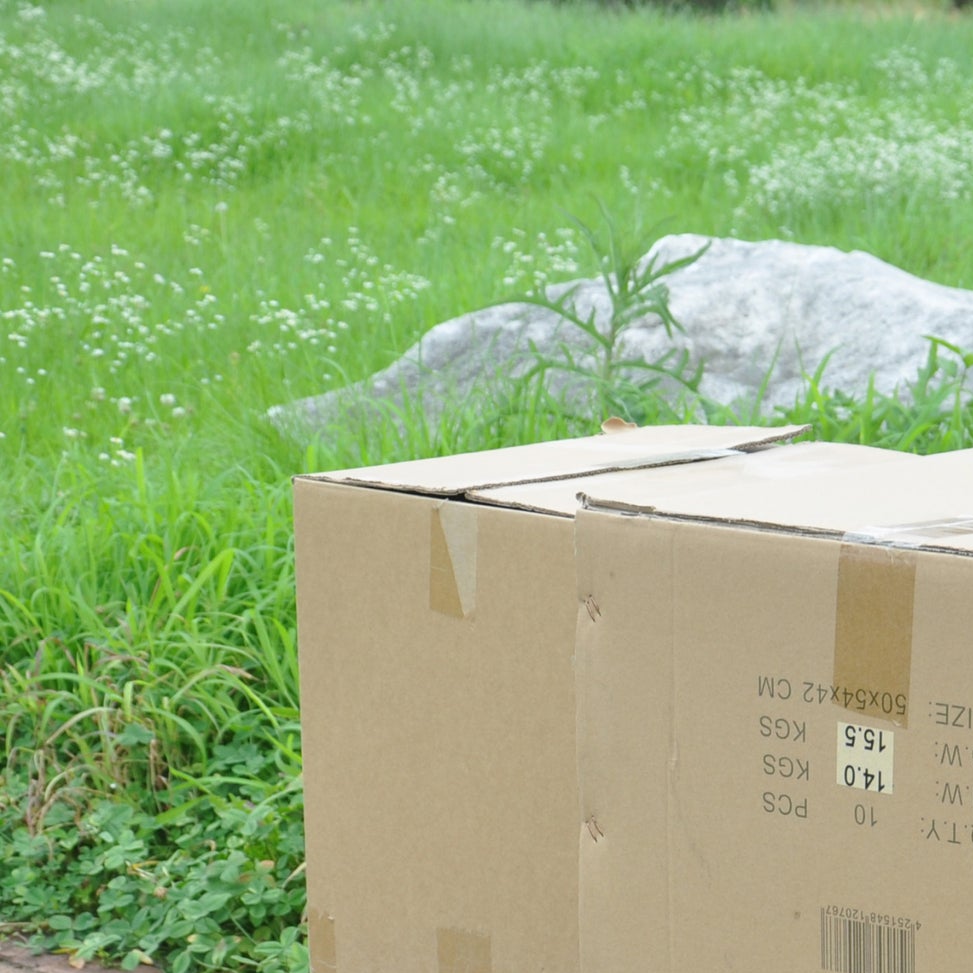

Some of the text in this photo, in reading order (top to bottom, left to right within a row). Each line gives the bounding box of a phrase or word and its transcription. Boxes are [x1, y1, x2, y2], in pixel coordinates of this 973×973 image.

[758, 675, 792, 700] CM
[803, 681, 907, 715] 50x54x42
[760, 715, 806, 743] KGS
[845, 725, 887, 752] 15.5
[763, 754, 809, 781] KGS
[844, 764, 885, 792] 14.0
[763, 791, 808, 819] PCS
[854, 804, 878, 827] 10
[826, 905, 922, 931] 4 251548 120767
